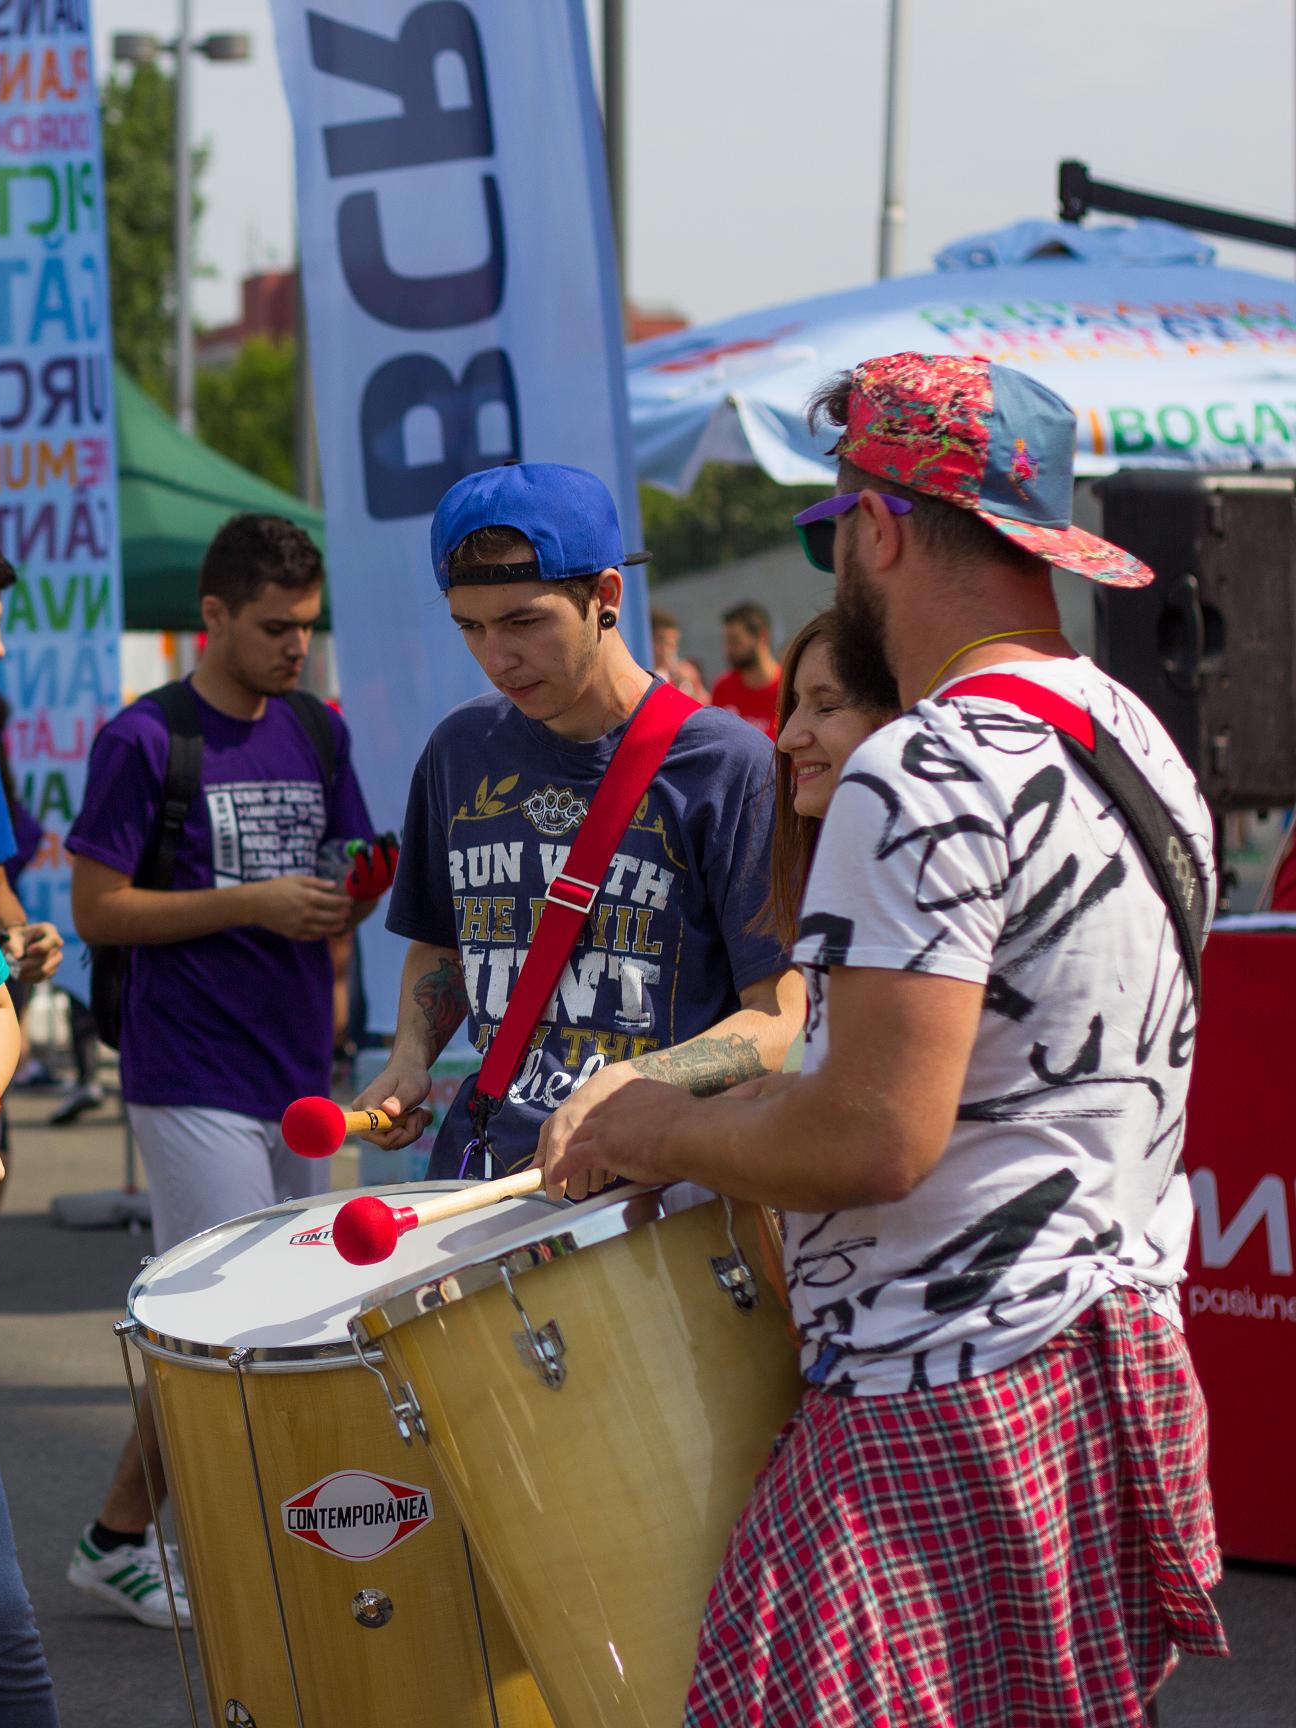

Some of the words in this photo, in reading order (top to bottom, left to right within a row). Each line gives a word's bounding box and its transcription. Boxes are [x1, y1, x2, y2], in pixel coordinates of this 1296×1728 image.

[307, 0, 524, 522] BCR
[1108, 401, 1296, 456] BOGA
[539, 843, 675, 911] WTH
[453, 895, 517, 943] HE
[289, 1230, 334, 1245] CONT
[287, 1495, 429, 1530] CONTEMPORÂNEA
